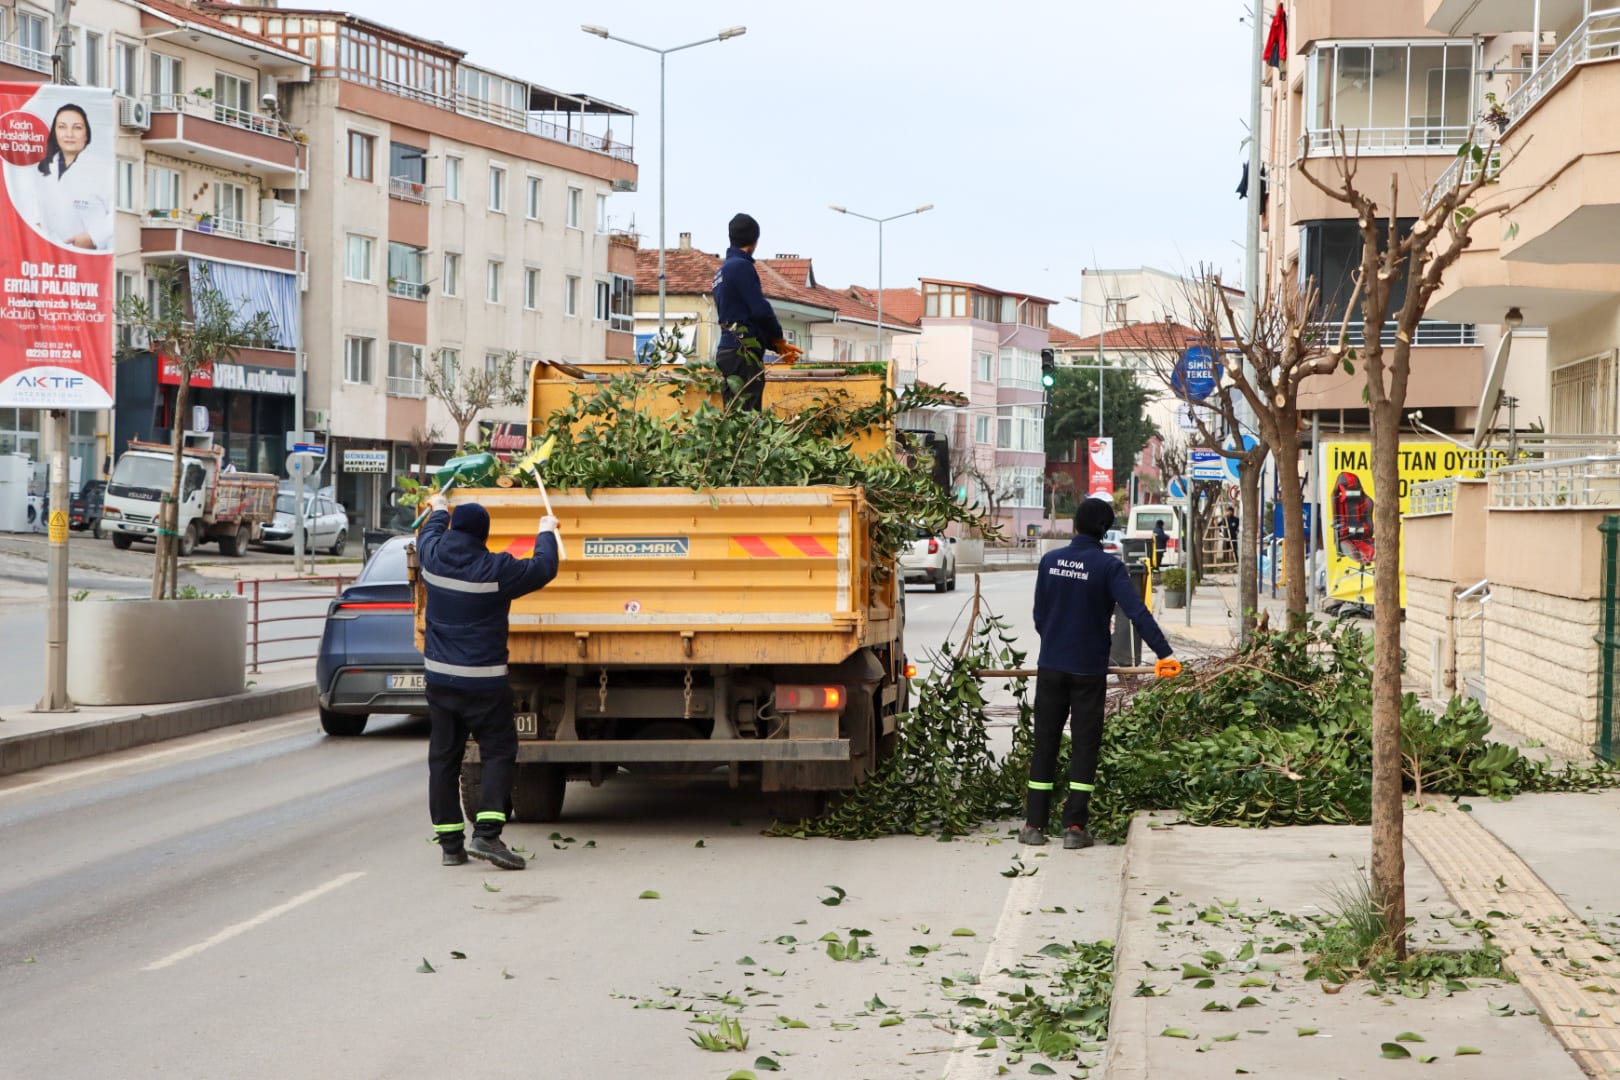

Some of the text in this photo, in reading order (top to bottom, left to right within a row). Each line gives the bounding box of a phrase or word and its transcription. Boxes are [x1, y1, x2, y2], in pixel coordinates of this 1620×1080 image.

[11, 141, 43, 154] Doğum
[4, 278, 99, 297] ERTAN PALABIYIK
[8, 297, 97, 310] Hastanemizde Hasta
[0, 306, 36, 321] Kabulü
[1186, 370, 1213, 379] TEKEL
[1057, 559, 1084, 570] YALOVA
[393, 676, 405, 687] 77
